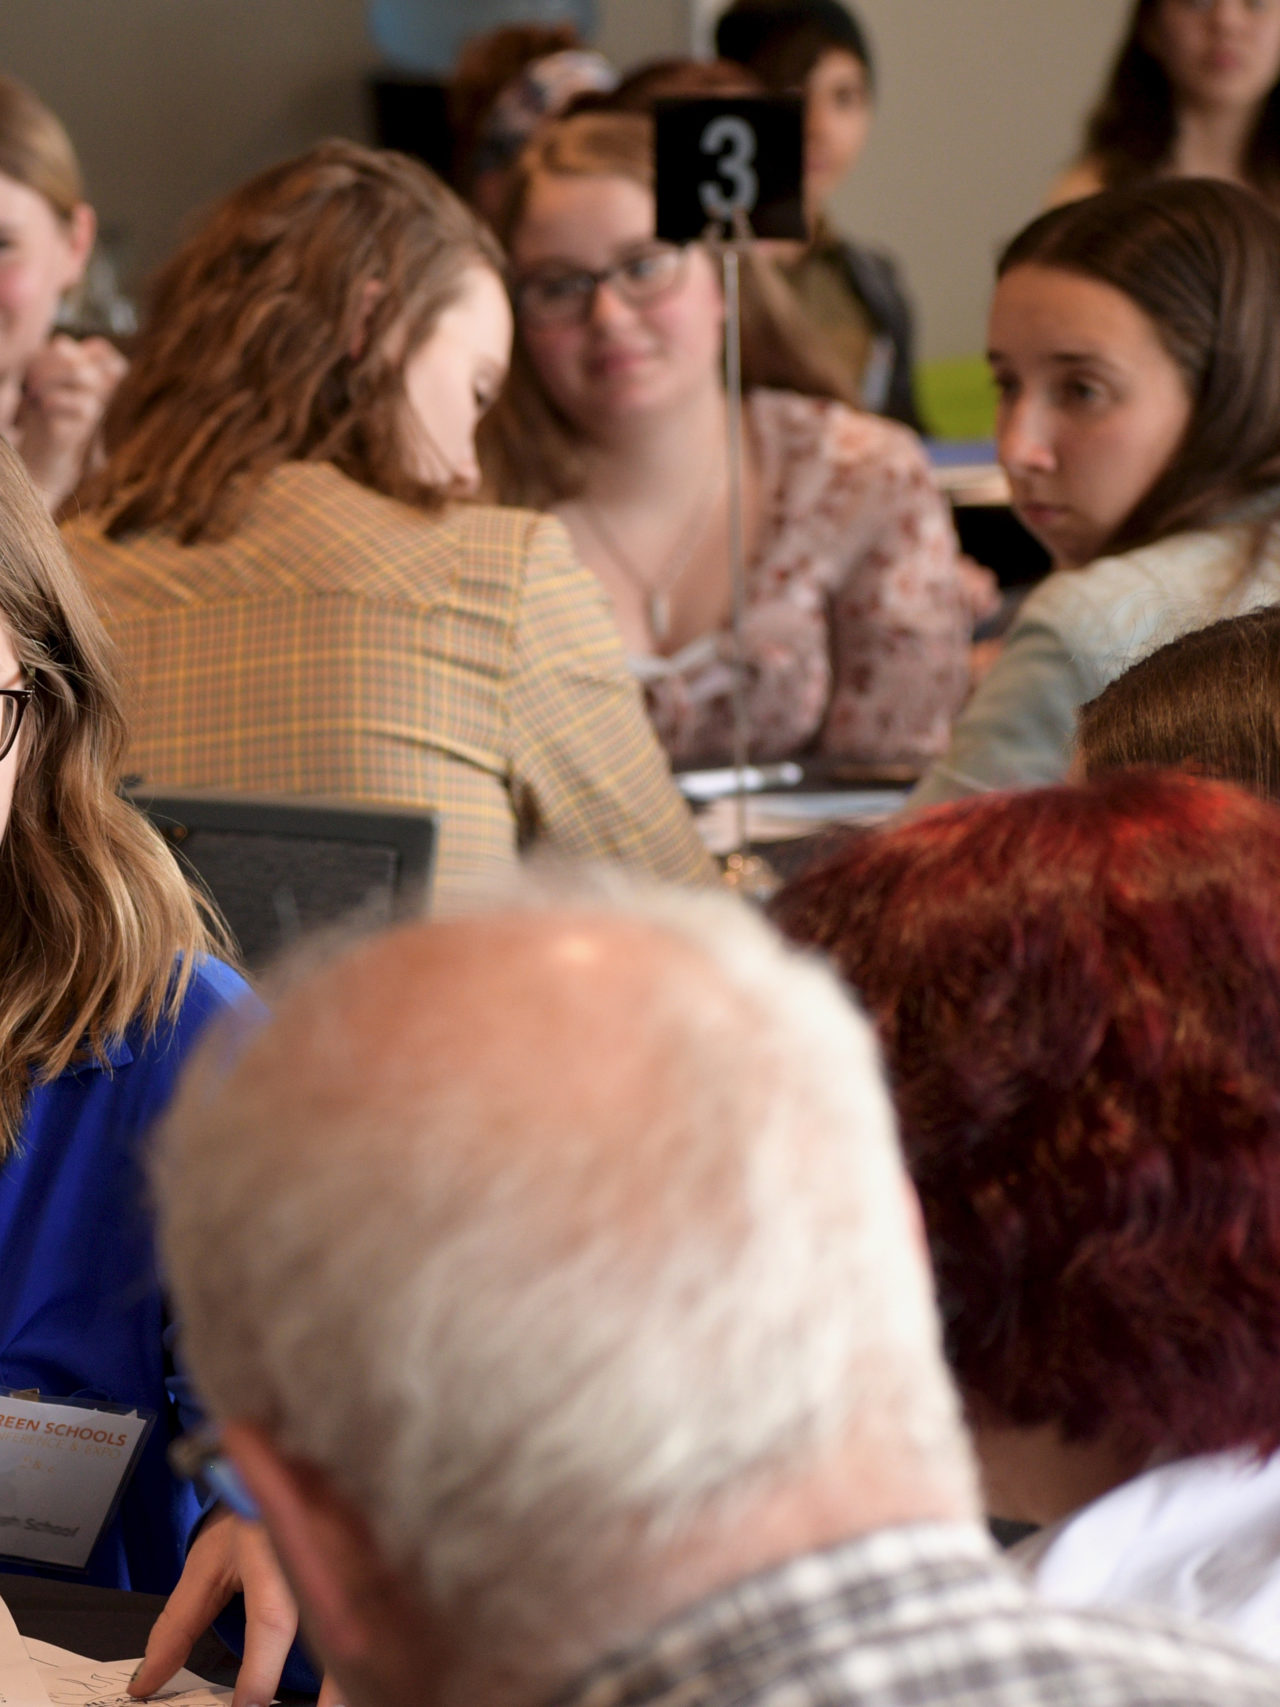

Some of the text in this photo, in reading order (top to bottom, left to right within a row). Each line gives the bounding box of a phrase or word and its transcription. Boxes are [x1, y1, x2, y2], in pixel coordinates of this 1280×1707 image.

[698, 114, 759, 221] 3
[44, 1422, 128, 1447] SCHOOLS
[83, 1445, 121, 1460] EXPO
[23, 1517, 81, 1538] School
